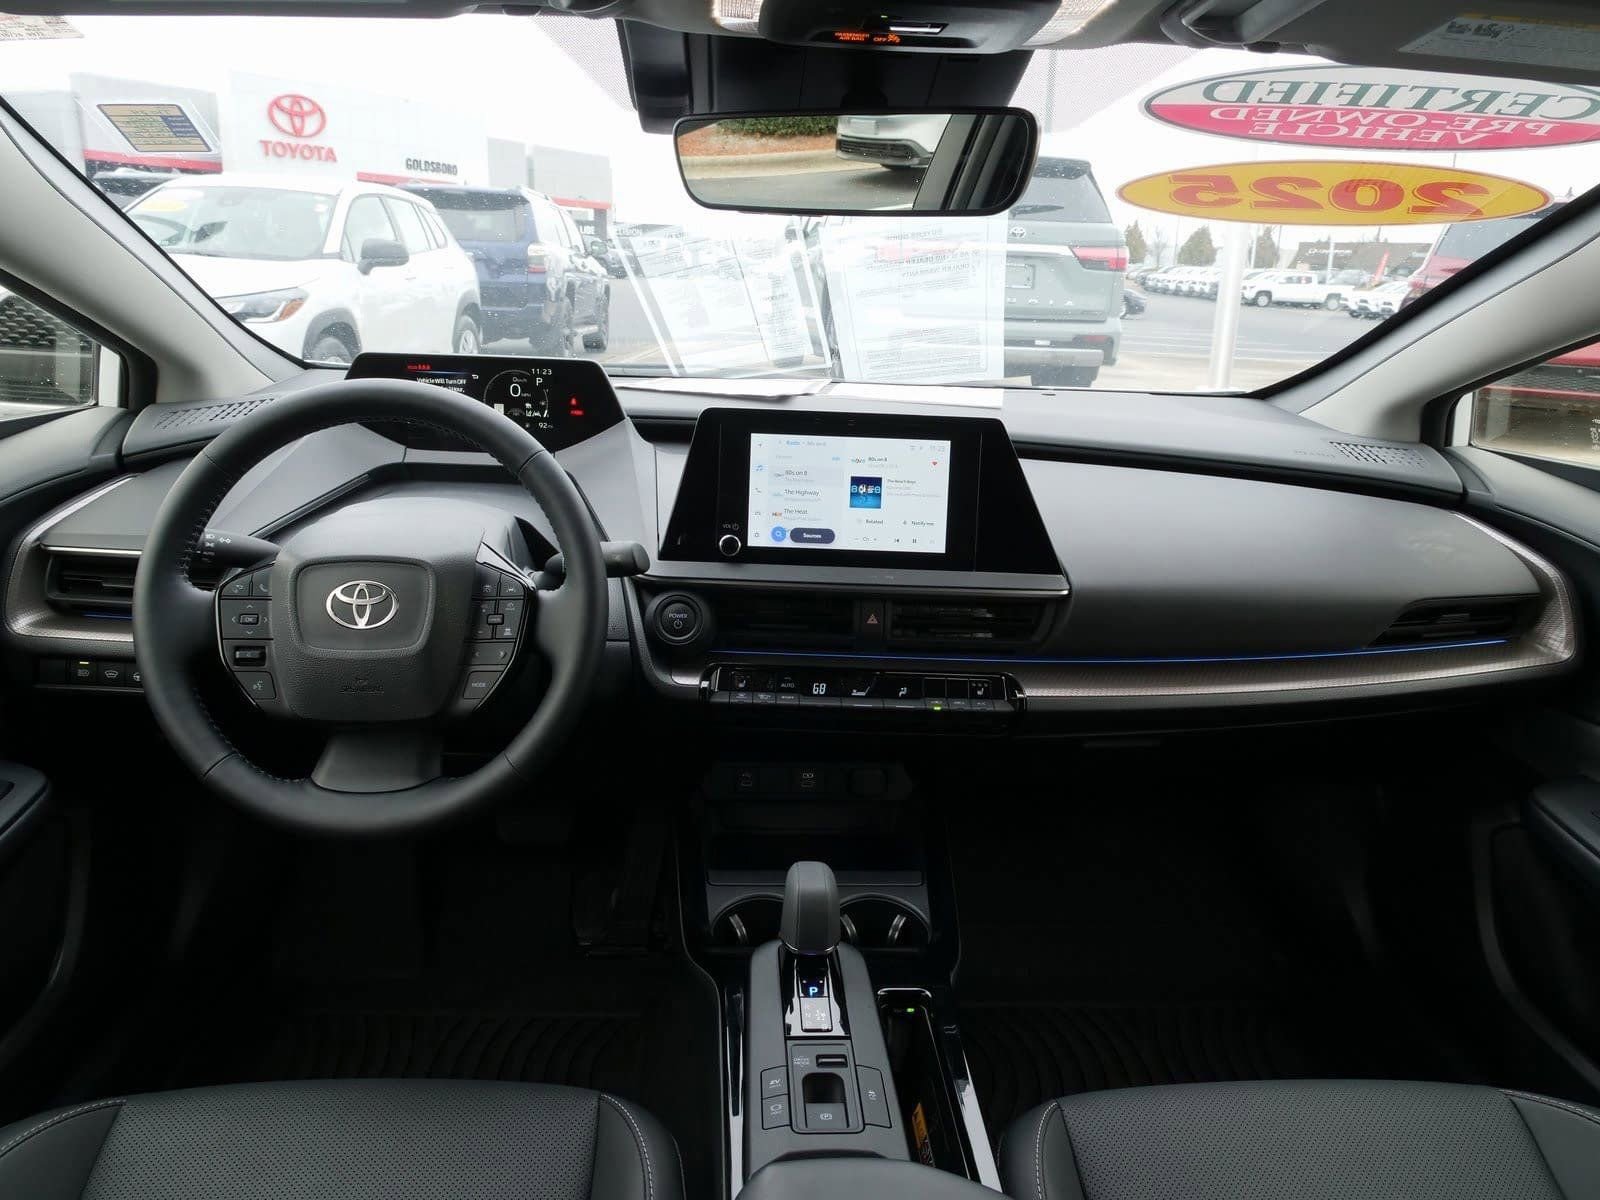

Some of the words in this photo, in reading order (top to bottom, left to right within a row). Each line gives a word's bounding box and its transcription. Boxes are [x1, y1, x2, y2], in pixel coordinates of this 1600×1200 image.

[259, 139, 338, 163] TOYOTA
[405, 157, 458, 176] GOLDSBORO
[535, 377, 543, 387] P
[509, 383, 521, 397] 0
[795, 489, 820, 497] Highway
[812, 682, 827, 695] 68
[809, 987, 818, 997] P
